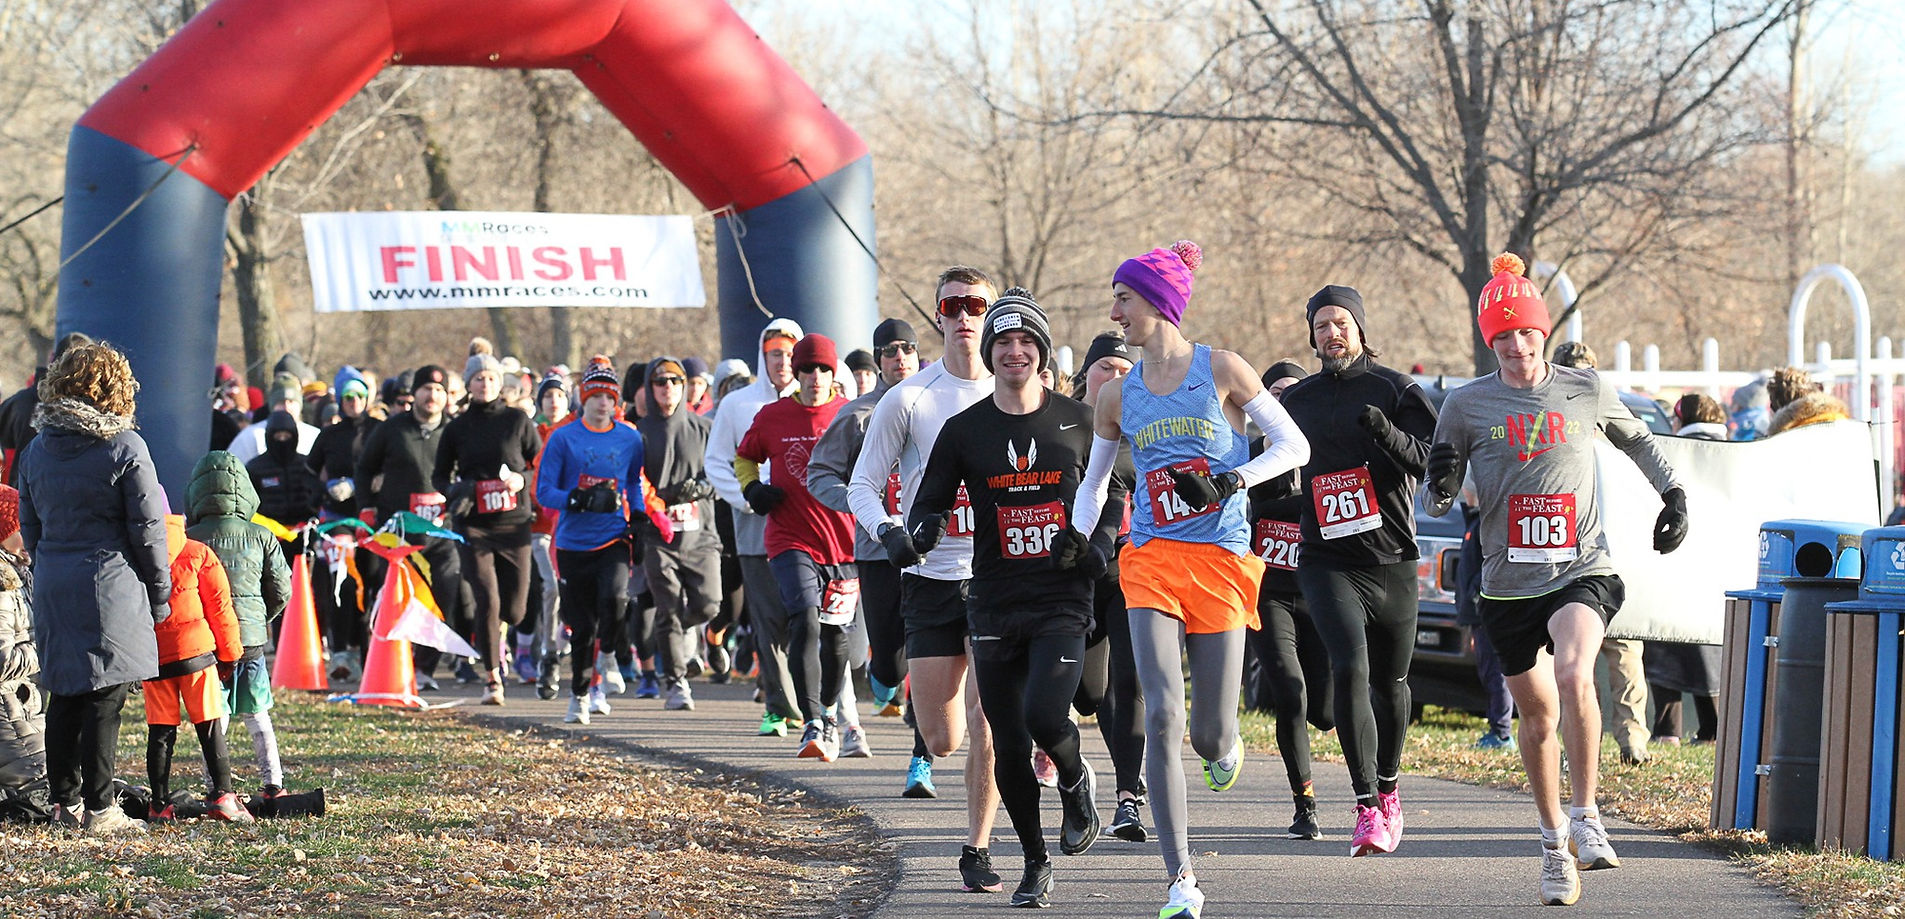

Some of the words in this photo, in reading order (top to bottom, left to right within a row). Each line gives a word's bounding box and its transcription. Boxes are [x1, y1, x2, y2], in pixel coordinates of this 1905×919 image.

[380, 246, 627, 283] FINISH
[369, 285, 648, 300] www.mmraces.com
[1133, 416, 1216, 452] WHITEWATER
[1490, 425, 1505, 440] 20
[1506, 411, 1567, 447] NXR
[1566, 420, 1580, 434] 22
[986, 474, 1015, 489] WHITE
[1015, 472, 1039, 486] BEAR
[1039, 470, 1063, 485] LAKE
[1321, 475, 1342, 486] FAST
[1331, 477, 1359, 491] FEAST
[482, 489, 511, 511] 101
[1157, 488, 1209, 521] 14
[1322, 487, 1370, 523] 261
[1523, 497, 1546, 506] FAST
[1533, 504, 1563, 513] FEAST
[1011, 509, 1034, 518] FAST
[1021, 513, 1052, 524] FEAST
[1268, 522, 1287, 531] FAST
[1275, 529, 1301, 540] FEAST
[1517, 515, 1568, 546] 103
[1006, 523, 1060, 556] 336
[1261, 537, 1299, 568] 220
